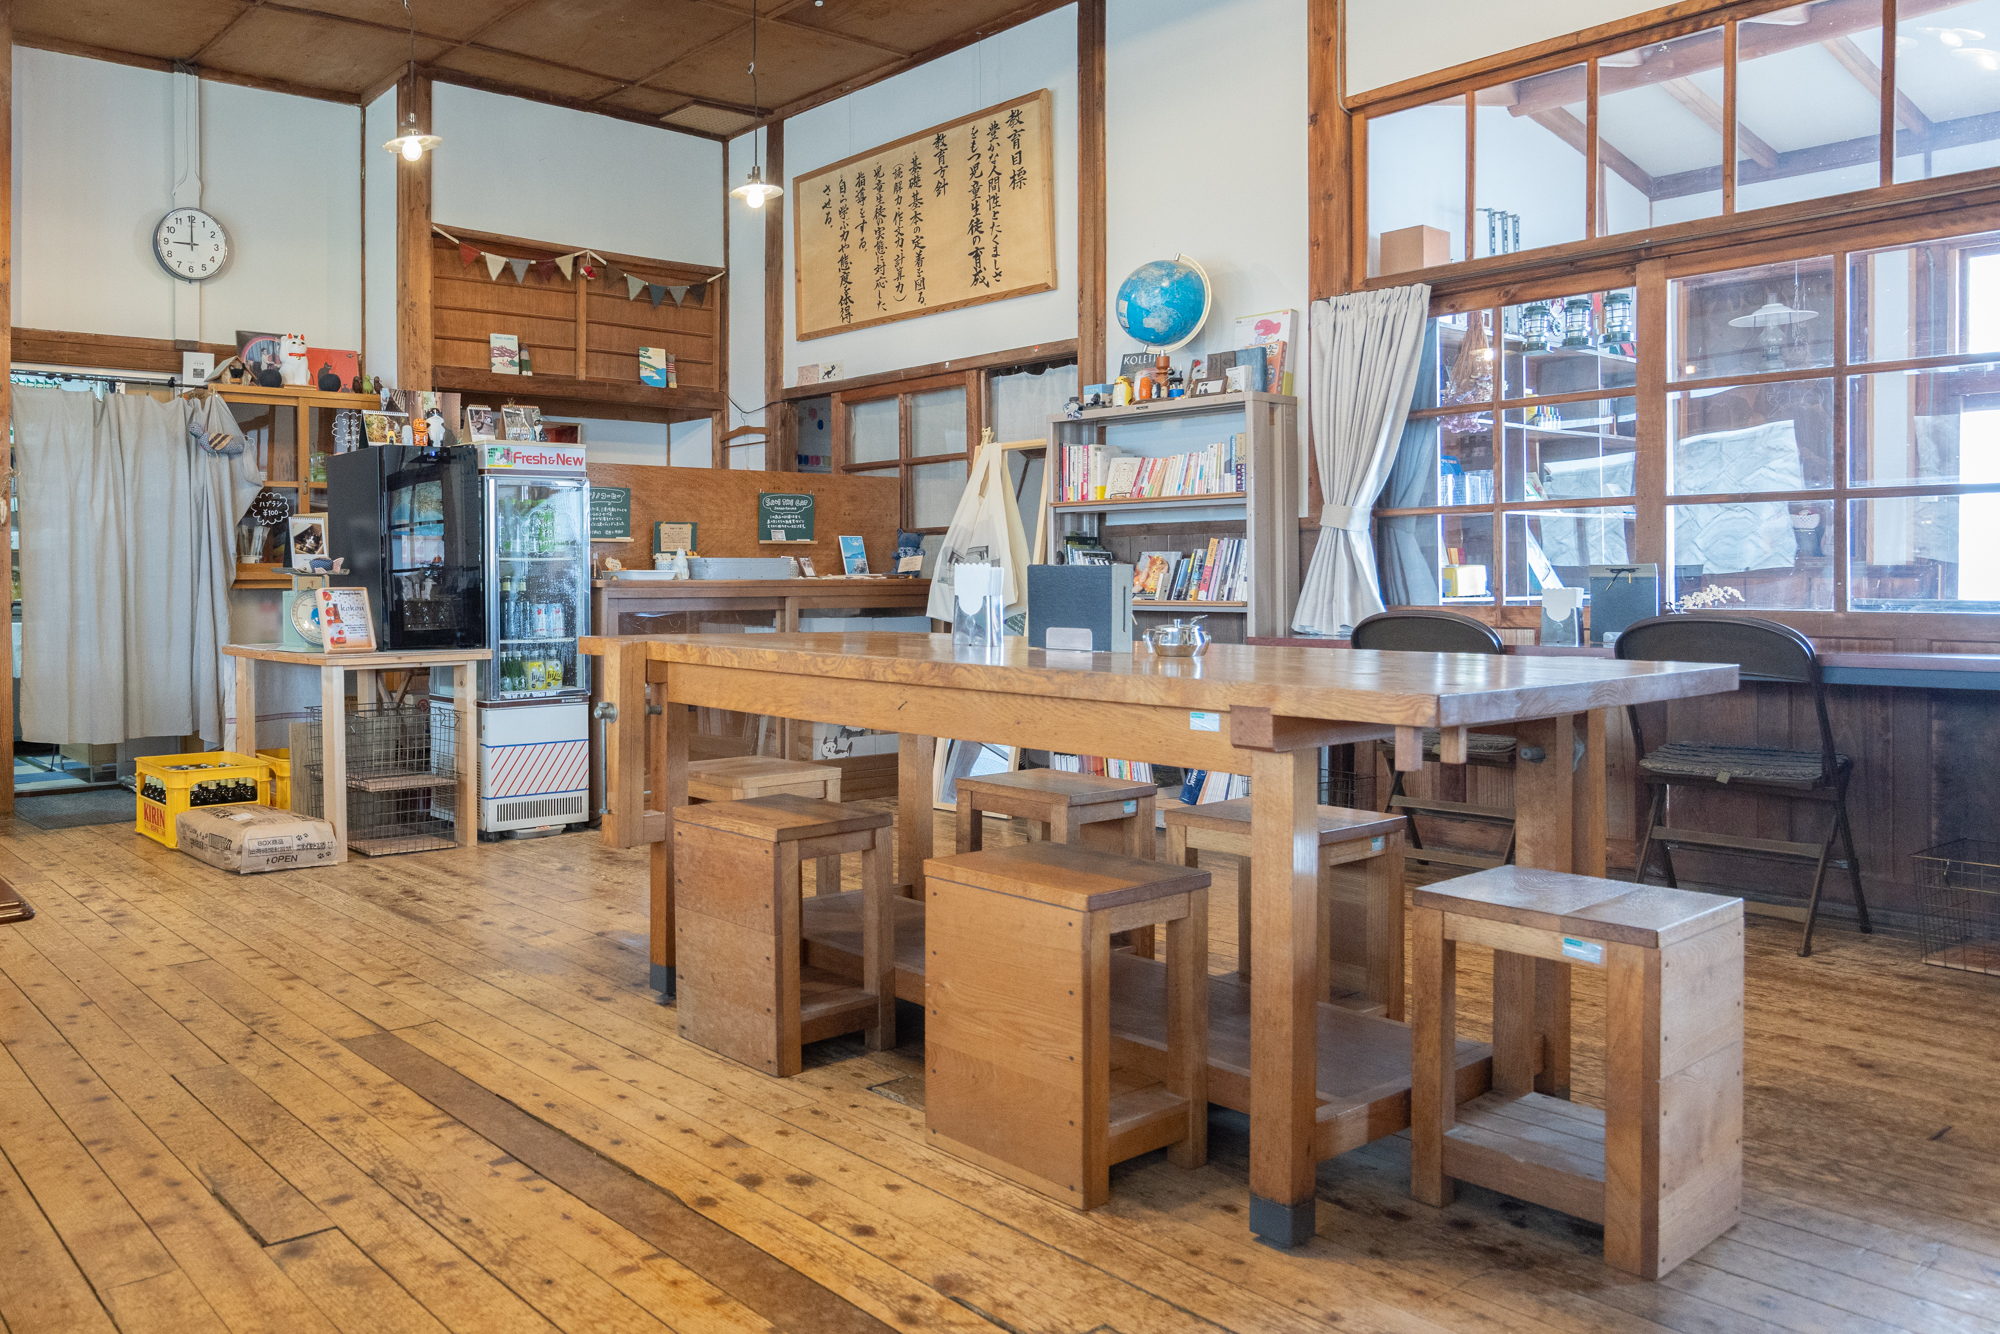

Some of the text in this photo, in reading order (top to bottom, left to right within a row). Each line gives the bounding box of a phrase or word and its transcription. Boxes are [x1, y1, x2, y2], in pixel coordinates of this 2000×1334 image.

[1005, 109, 1027, 191] 教育目標
[932, 133, 949, 198] 教育方針
[986, 120, 1003, 283] 豊かな人間性とたくましさ
[967, 125, 990, 288] をもつ児童生徒の育成
[175, 217, 183, 225] 11
[187, 215, 196, 223] 12
[201, 220, 206, 228] 1
[166, 226, 176, 234] 10
[163, 237, 169, 245] 9
[213, 244, 219, 252] 3
[166, 250, 173, 258] 8
[176, 260, 182, 268] 7
[143, 802, 166, 829] KIRIN
[271, 854, 298, 864] OPEN
